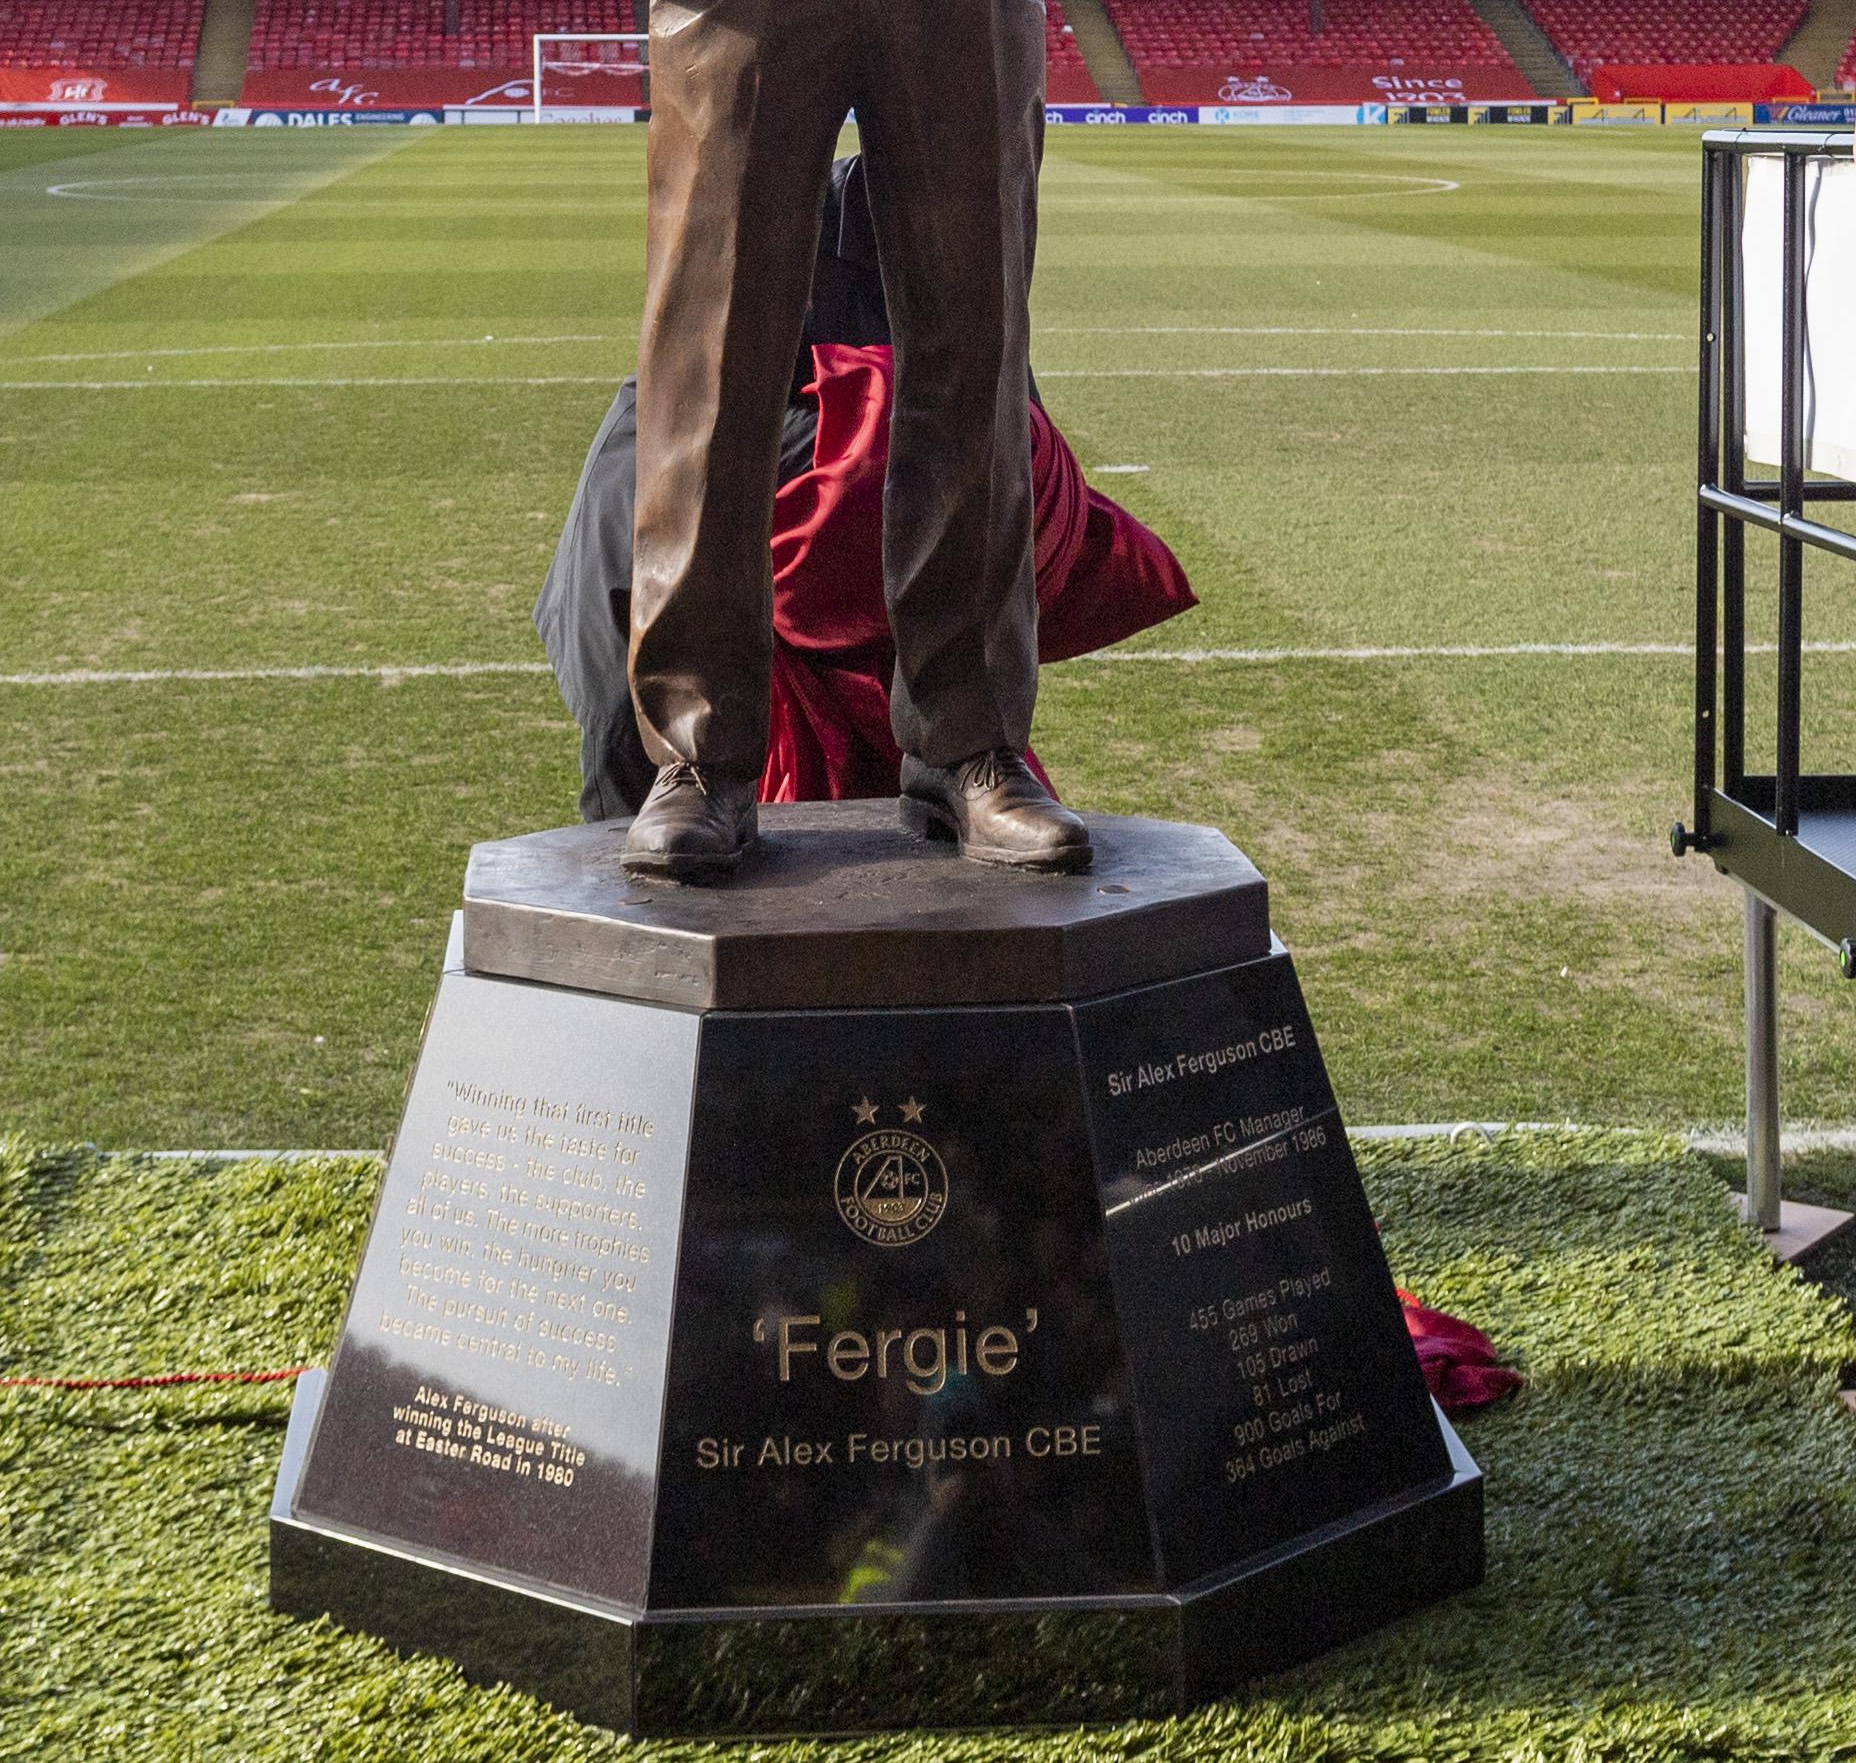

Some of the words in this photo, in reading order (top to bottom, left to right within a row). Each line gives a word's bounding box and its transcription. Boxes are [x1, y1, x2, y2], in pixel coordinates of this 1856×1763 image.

[1371, 76, 1463, 89] Since
[59, 111, 108, 126] GLEN'S
[162, 111, 210, 126] GLEN'S
[289, 112, 352, 126] DALES
[1086, 109, 1125, 124] cinch
[1149, 109, 1187, 124] cinch
[1787, 105, 1841, 121] Gleaner
[1107, 1072, 1132, 1096] Sir
[1137, 1063, 1175, 1088] Alex
[1176, 1042, 1257, 1076] Ferguson
[1259, 1026, 1296, 1054] CBE
[447, 1115, 491, 1136] gave
[497, 1125, 517, 1143] us
[525, 1126, 555, 1149] the
[560, 1133, 607, 1161] taste
[614, 1141, 640, 1165] for
[534, 1096, 569, 1120] that
[575, 1102, 611, 1128] first
[618, 1111, 655, 1137] title
[1135, 1134, 1209, 1169] Aberdeen
[1213, 1121, 1237, 1146] FC
[1239, 1105, 1304, 1137] Manager
[1291, 1125, 1326, 1153] 1986
[432, 1141, 505, 1171] success
[528, 1157, 556, 1180] the
[615, 1174, 646, 1198] the
[853, 1136, 931, 1164] ABERDEEN
[500, 1184, 529, 1208] the
[905, 1173, 920, 1185] FC
[407, 1197, 427, 1217] all
[431, 1201, 451, 1220] of
[454, 1208, 478, 1227] us.
[487, 1209, 519, 1235] The
[523, 1221, 569, 1247] more
[574, 1229, 650, 1263] trophies
[841, 1196, 915, 1242] FOOTBALL
[915, 1192, 943, 1230] CLUB
[1171, 1233, 1191, 1256] 10
[1194, 1218, 1242, 1250] Major
[1244, 1197, 1313, 1233] Honours
[401, 1228, 433, 1249] you
[484, 1242, 512, 1265] the
[518, 1248, 597, 1283] hungrier
[602, 1271, 637, 1293] you
[399, 1255, 472, 1288] become
[478, 1271, 504, 1294] for
[509, 1278, 538, 1303] the
[544, 1288, 587, 1314] next
[592, 1300, 632, 1325] one.
[1189, 1304, 1219, 1331] 455
[1222, 1287, 1276, 1321] Games
[1278, 1267, 1331, 1300] Played
[407, 1284, 438, 1312] The
[442, 1298, 507, 1322] pursuit
[513, 1311, 535, 1332] of
[539, 1319, 617, 1353] success
[1229, 1323, 1259, 1352] 269
[1263, 1312, 1299, 1337] Won
[377, 1307, 451, 1346] became
[457, 1332, 523, 1364] central
[528, 1348, 545, 1368] to
[552, 1354, 581, 1381] my
[1237, 1353, 1266, 1380] 105
[1270, 1336, 1319, 1369] Drawn
[415, 1385, 449, 1411] Alex
[453, 1394, 526, 1429] Ferguson
[531, 1416, 571, 1439] after
[1253, 1382, 1271, 1407] 81
[1276, 1370, 1313, 1398] Lost
[393, 1405, 452, 1436] winning
[457, 1418, 482, 1441] the
[487, 1426, 544, 1455] League
[551, 1441, 585, 1467] Title
[1234, 1417, 1265, 1447] 900
[1268, 1400, 1313, 1434] Goals
[1314, 1391, 1341, 1415] For
[1259, 1437, 1305, 1469] Goals
[1308, 1413, 1367, 1452] Against
[395, 1427, 412, 1446] at
[416, 1433, 467, 1458] Easter
[470, 1445, 512, 1471] Road
[516, 1455, 531, 1477] in
[537, 1463, 574, 1488] 1980
[696, 1435, 745, 1469] Sir
[757, 1437, 833, 1466] Alex
[849, 1432, 1012, 1469] Ferguson
[1025, 1426, 1102, 1456] CBE
